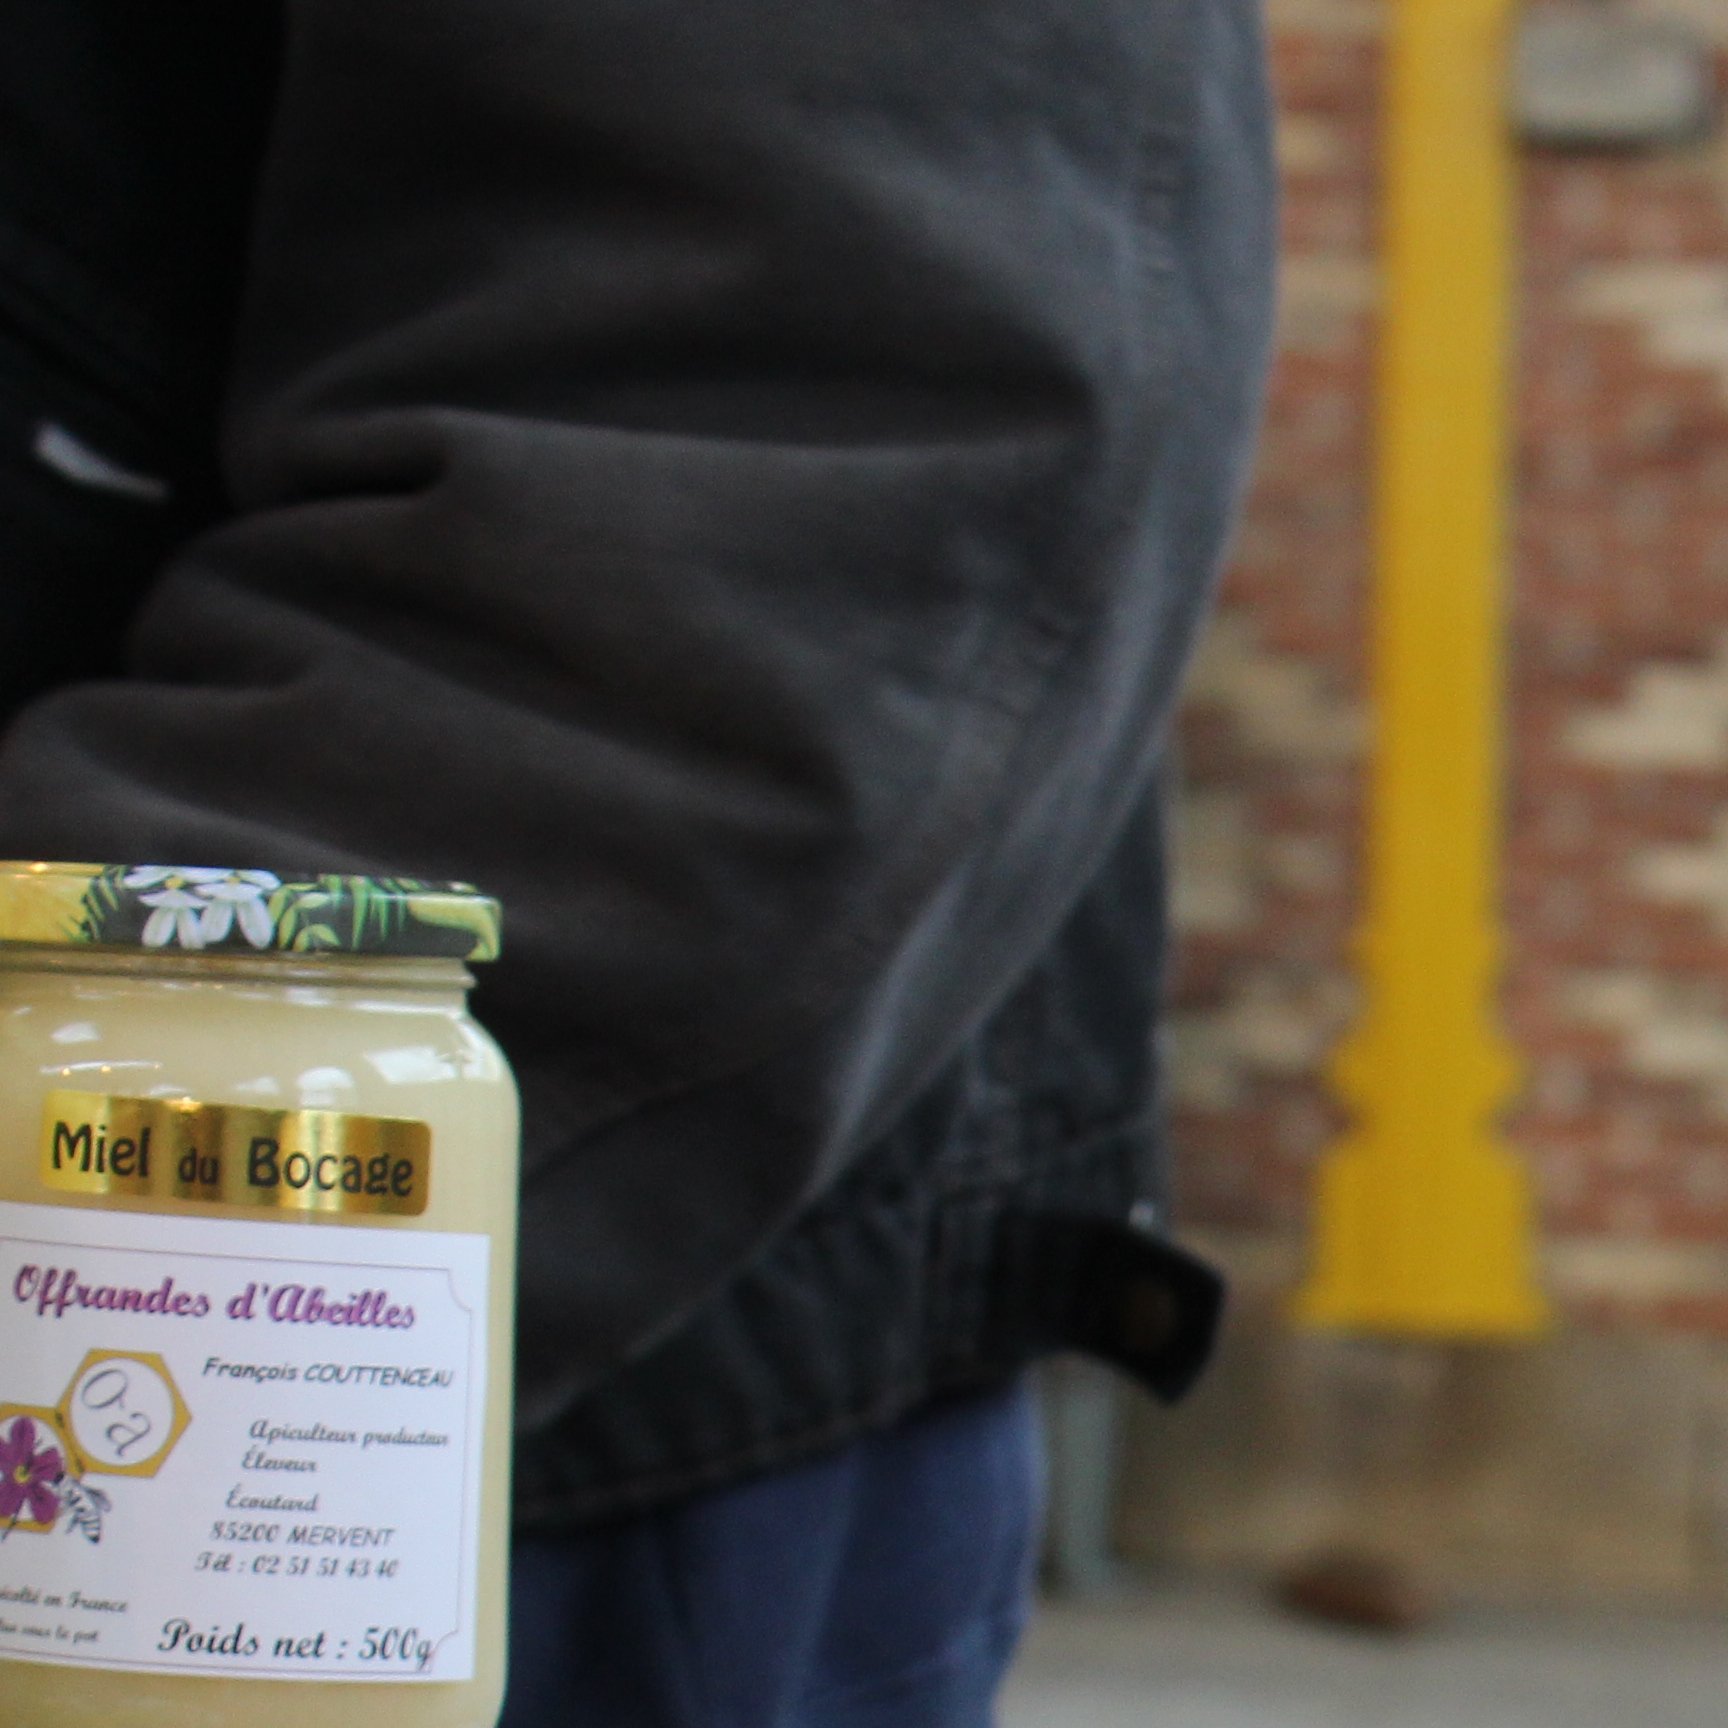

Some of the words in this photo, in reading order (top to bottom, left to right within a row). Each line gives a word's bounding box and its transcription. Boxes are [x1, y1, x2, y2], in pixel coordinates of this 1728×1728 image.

[53, 1120, 150, 1178] Miel
[178, 1147, 219, 1185] du
[247, 1136, 414, 1197] Bocage
[13, 1263, 211, 1320] Offrandes
[225, 1281, 417, 1331] d'Abeilles
[201, 1357, 298, 1384] François
[286, 1526, 395, 1548] MERVENT
[157, 1617, 260, 1658] Poids
[272, 1626, 325, 1660] net
[357, 1627, 434, 1673] 500g
